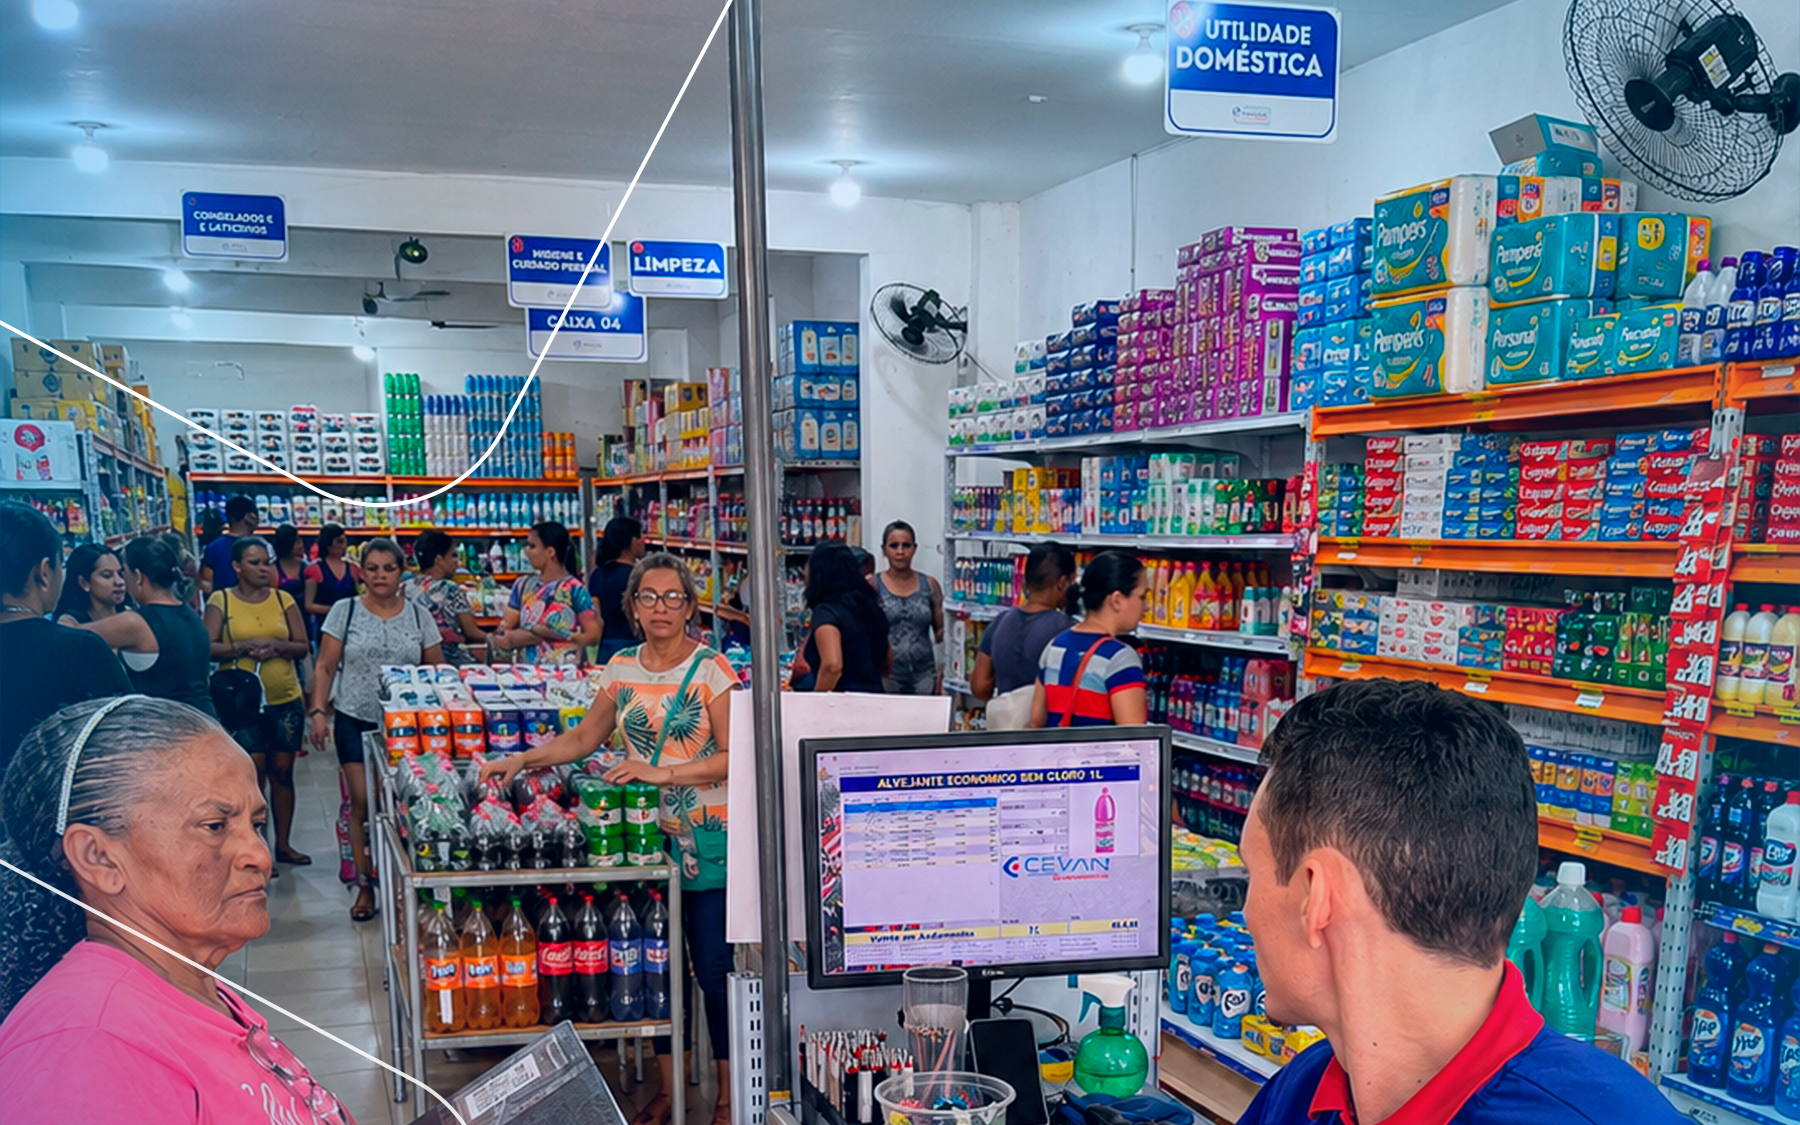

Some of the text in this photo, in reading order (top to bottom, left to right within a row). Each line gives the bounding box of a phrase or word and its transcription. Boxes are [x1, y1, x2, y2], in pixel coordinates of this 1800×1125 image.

[1205, 18, 1312, 46] UTILIDADE
[1175, 43, 1324, 78] DOMÉSTICA
[633, 255, 721, 274] LIMPEZA
[546, 314, 622, 331] CAIXA 04
[1024, 856, 1110, 873] CEVAN
